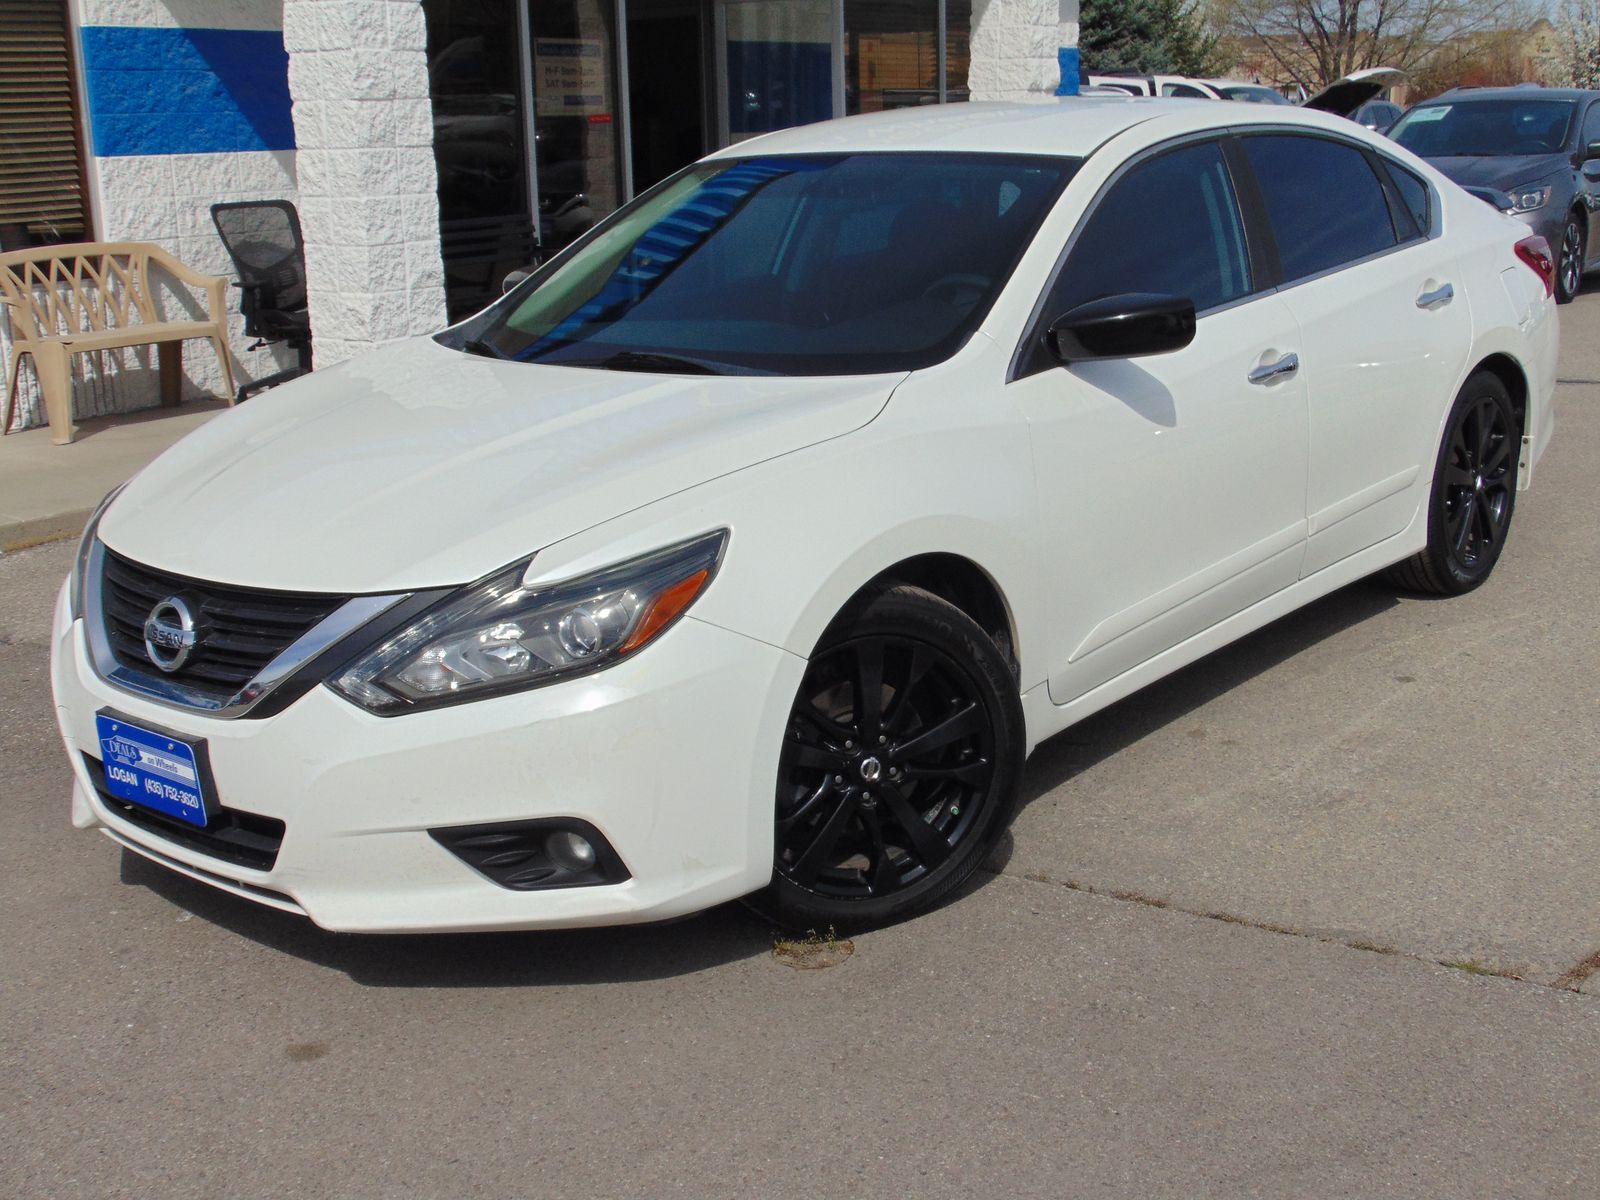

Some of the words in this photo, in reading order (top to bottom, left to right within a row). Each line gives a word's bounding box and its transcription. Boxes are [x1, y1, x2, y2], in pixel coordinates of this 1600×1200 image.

[146, 757, 155, 765] on
[154, 757, 179, 774] Wheels
[108, 765, 139, 787] LOGAN
[144, 778, 164, 799] (435)
[163, 785, 199, 809] 752-3620
